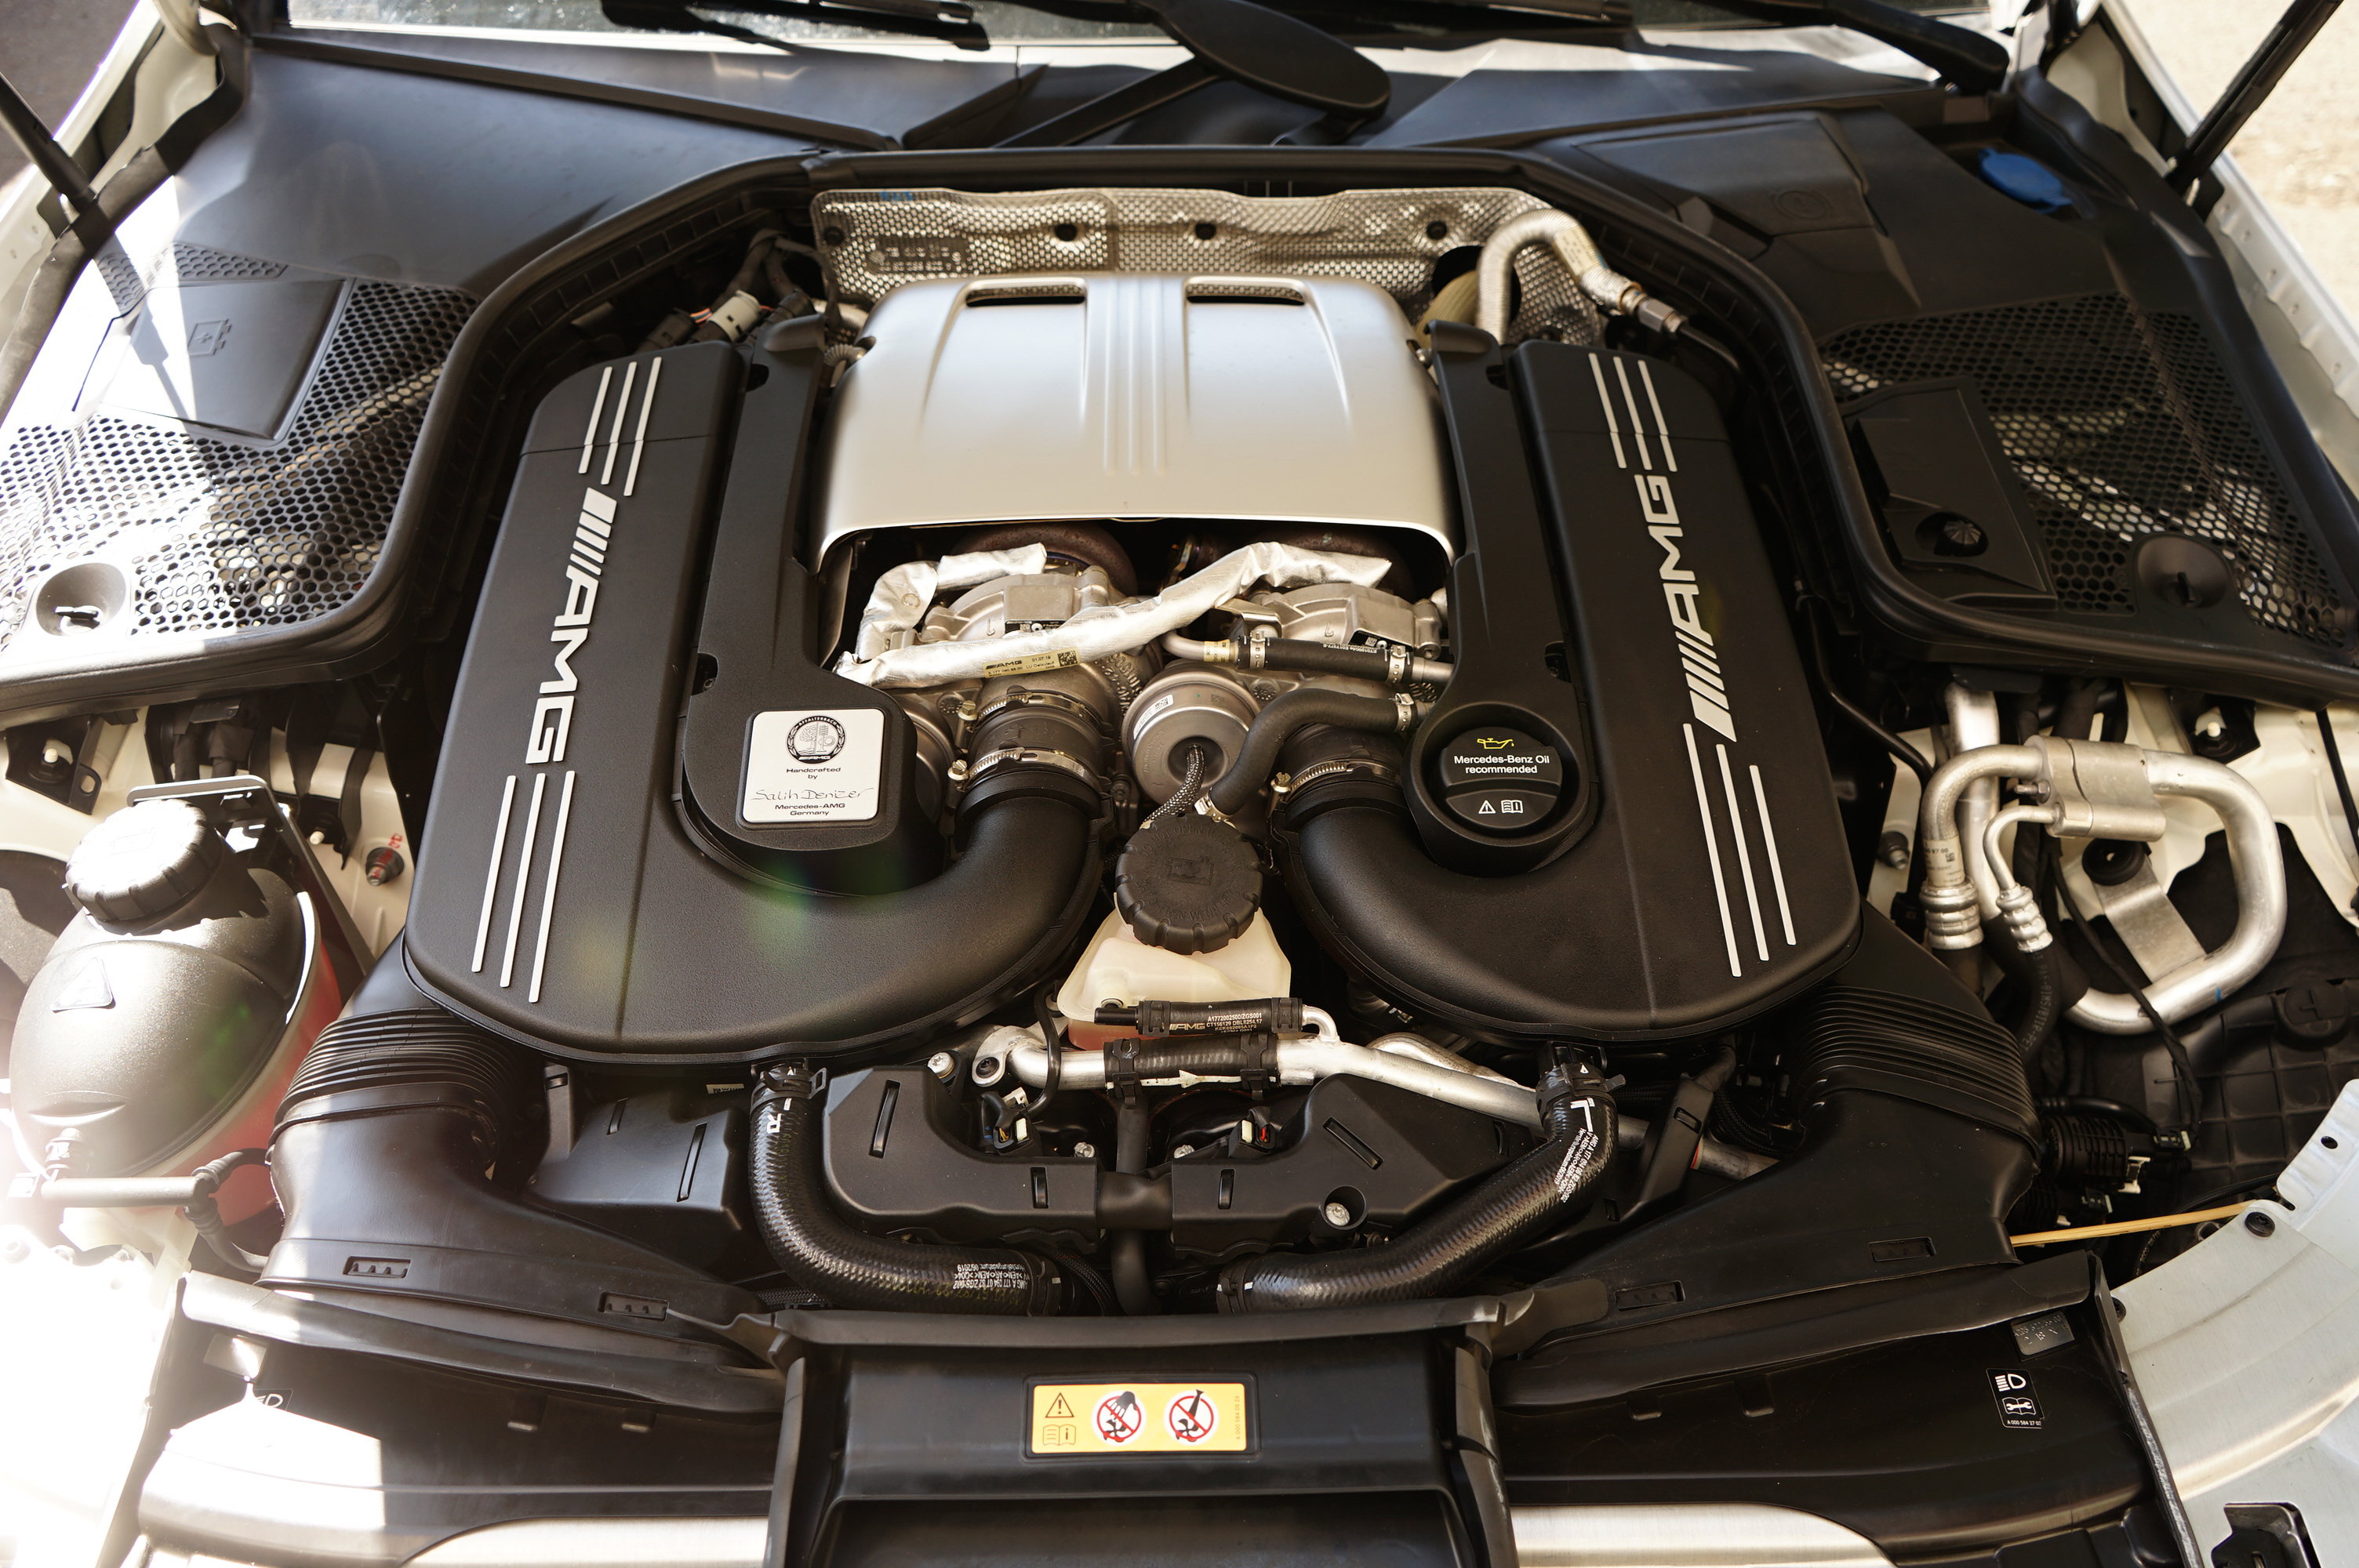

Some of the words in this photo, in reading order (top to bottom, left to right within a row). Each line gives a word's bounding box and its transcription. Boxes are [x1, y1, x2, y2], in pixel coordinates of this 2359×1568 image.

[1634, 474, 1714, 648] AMG
[525, 564, 599, 764] AMG
[798, 716, 838, 727] AFFALTERBACH
[1454, 755, 1533, 764] Mercedes-Benz
[1535, 755, 1550, 764] Oil
[1465, 765, 1538, 773] recommended
